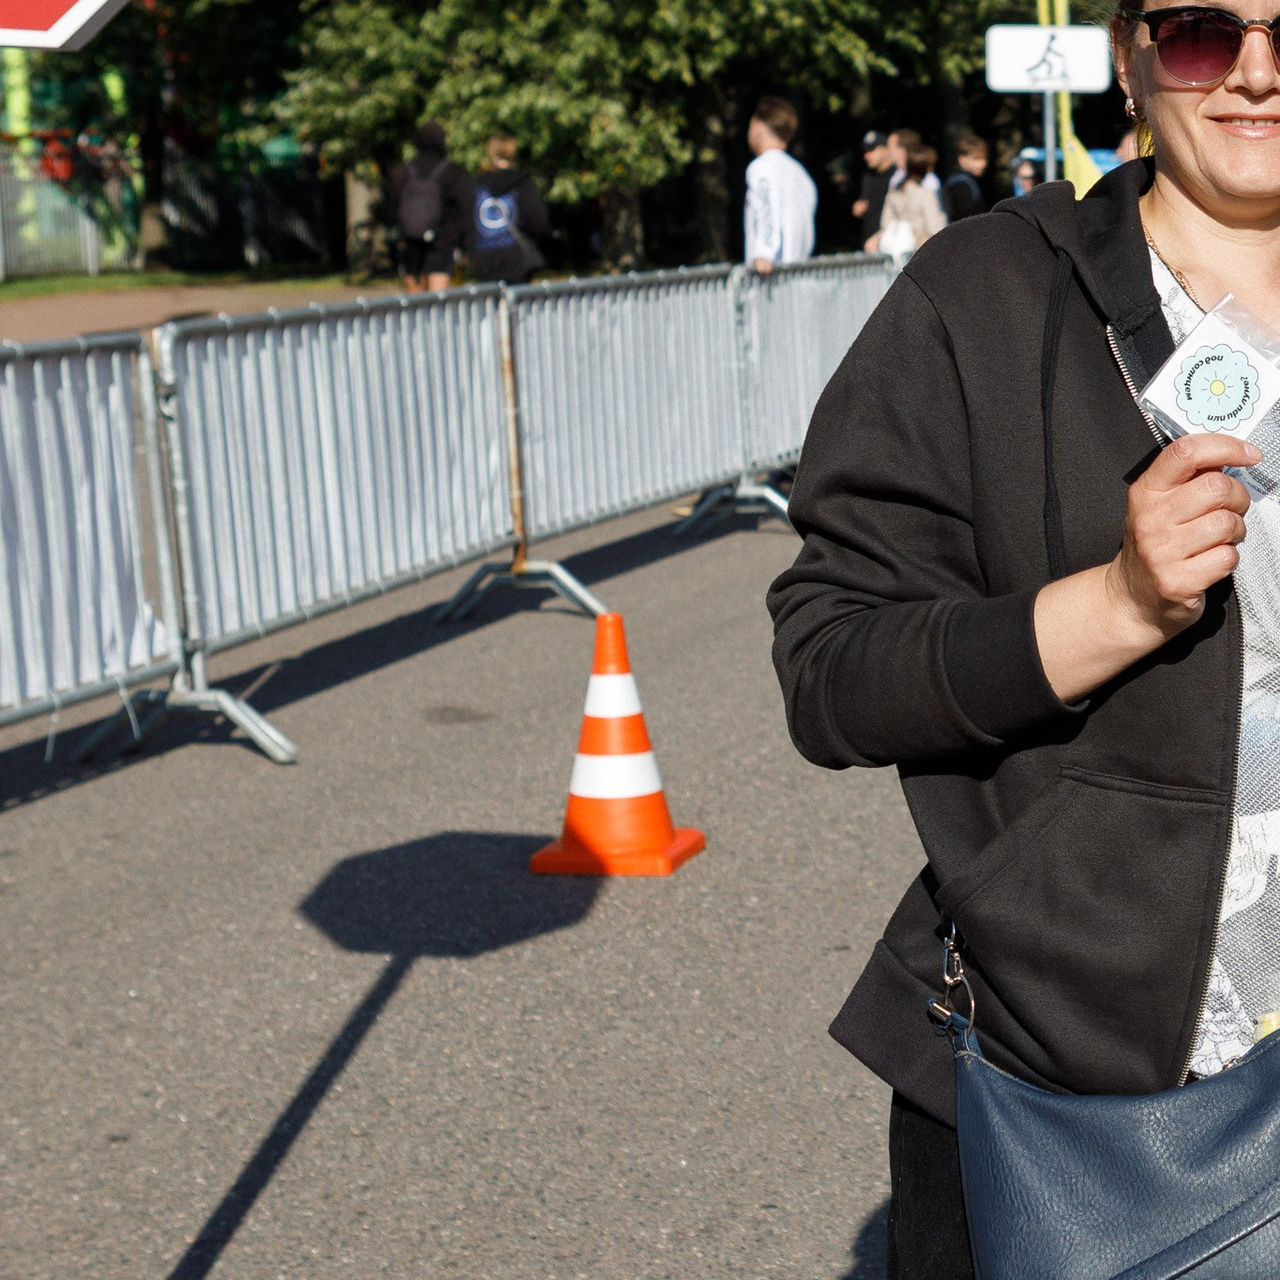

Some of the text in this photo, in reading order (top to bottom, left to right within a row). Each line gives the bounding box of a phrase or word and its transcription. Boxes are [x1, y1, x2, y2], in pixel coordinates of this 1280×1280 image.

[1184, 355, 1224, 401] под солнцем
[1207, 376, 1251, 422] или при луне?
